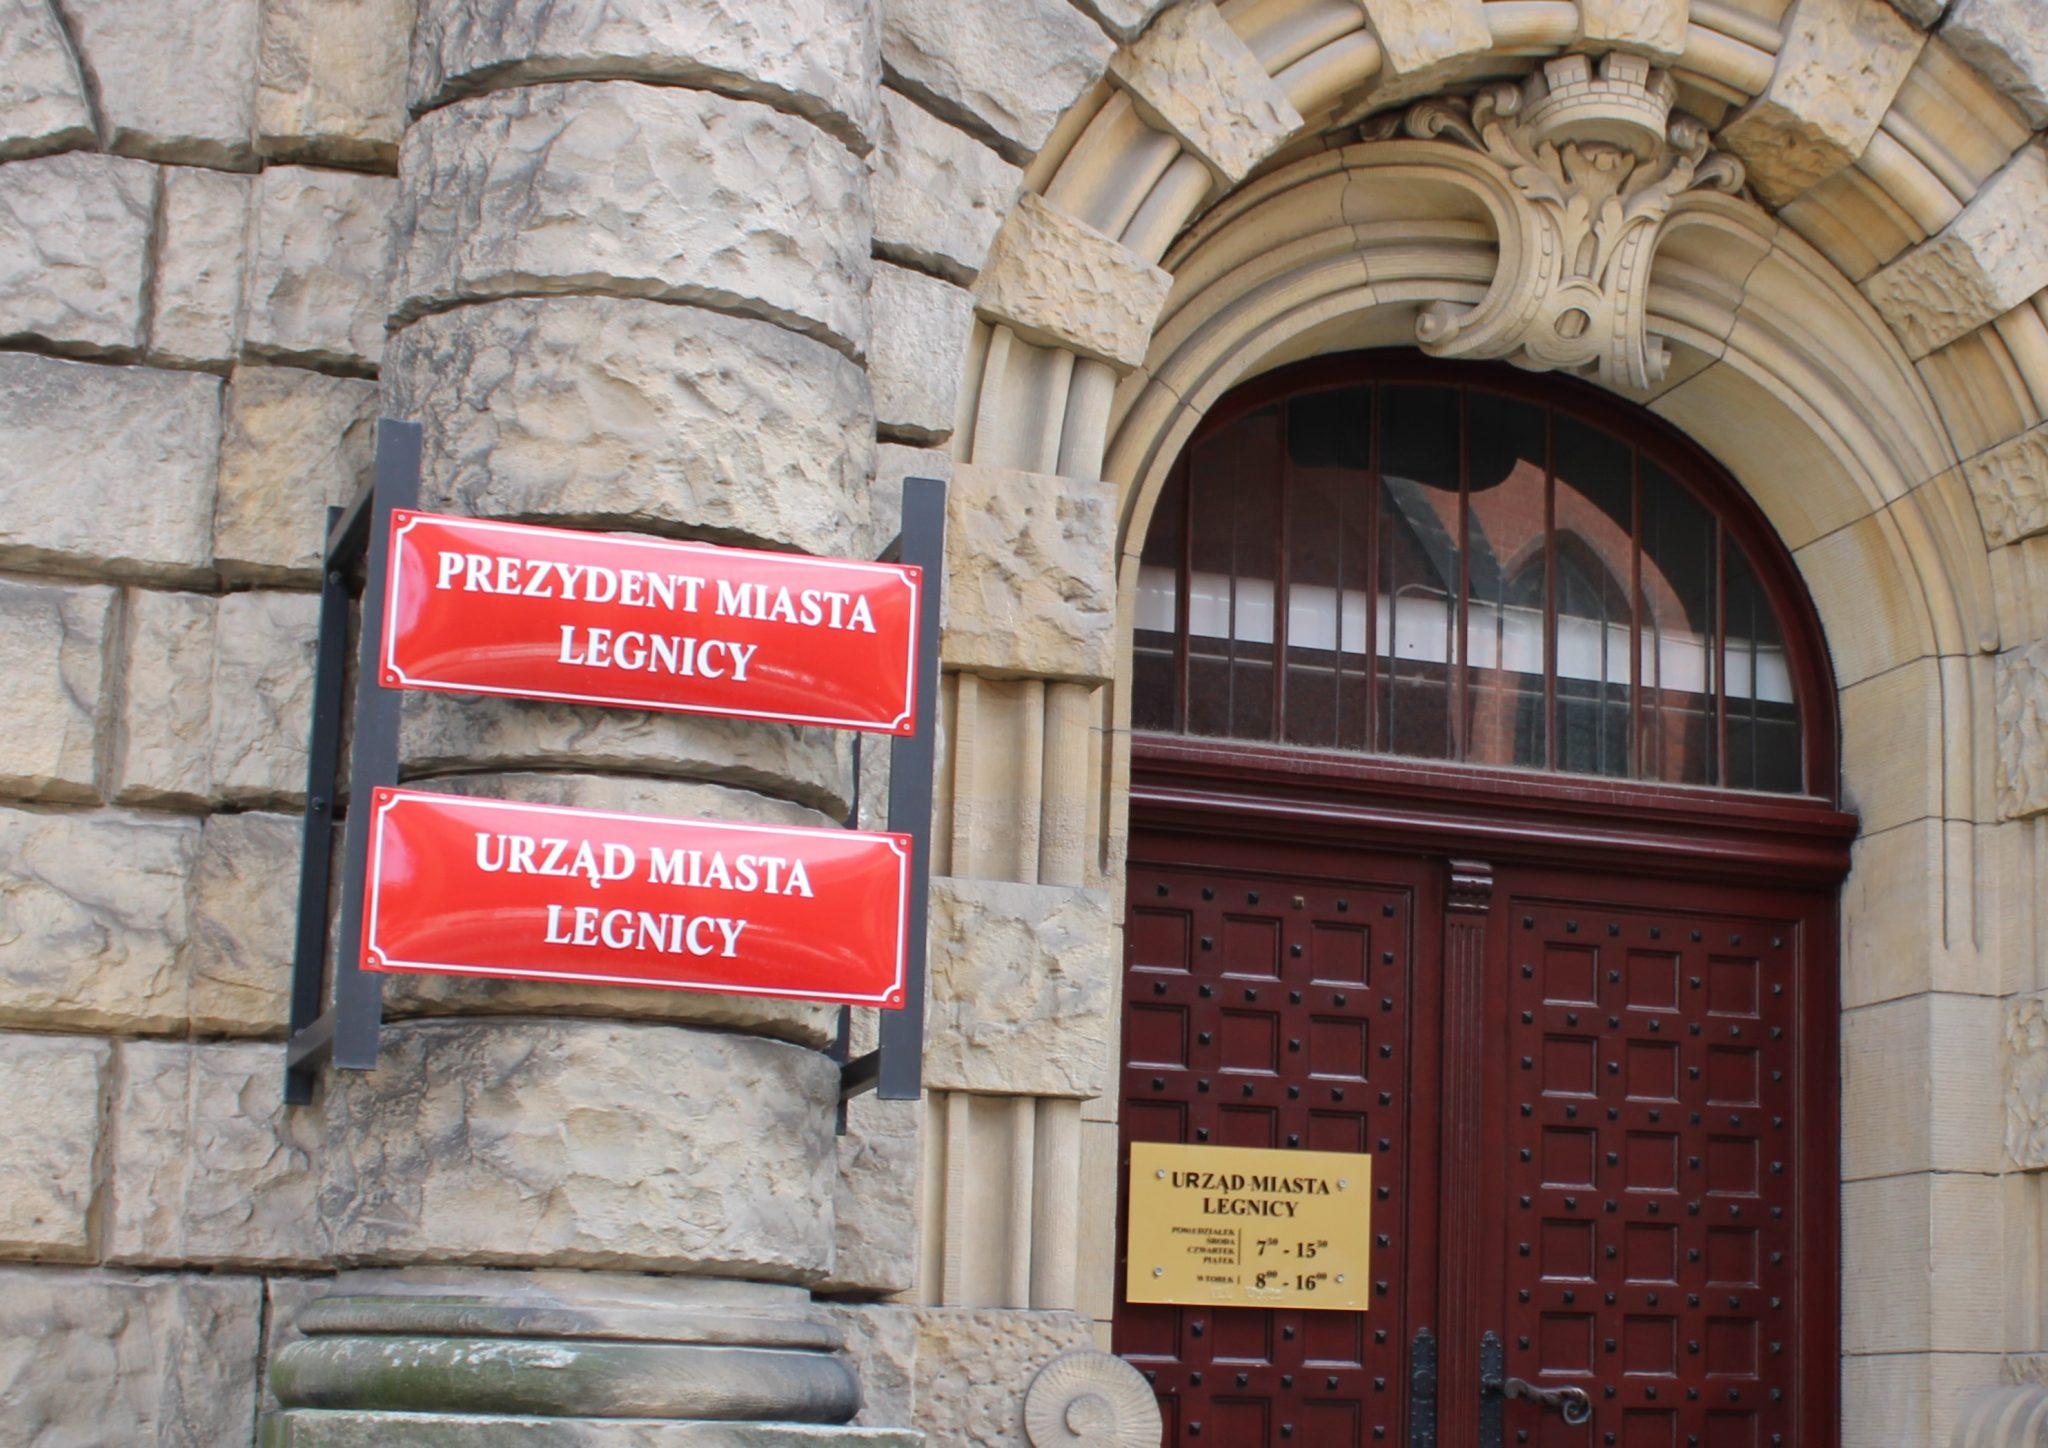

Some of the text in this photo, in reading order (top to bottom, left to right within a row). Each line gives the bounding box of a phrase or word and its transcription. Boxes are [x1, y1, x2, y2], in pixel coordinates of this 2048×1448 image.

[435, 551, 876, 634] PREZYDENT MIASTA
[558, 624, 757, 681] LEGNICY
[474, 832, 814, 898] URZĄD MIASTA
[543, 904, 746, 958] LEGNICY
[1171, 1171, 1330, 1195] URZĄD MIASTA
[1203, 1198, 1299, 1217] LEGNICY
